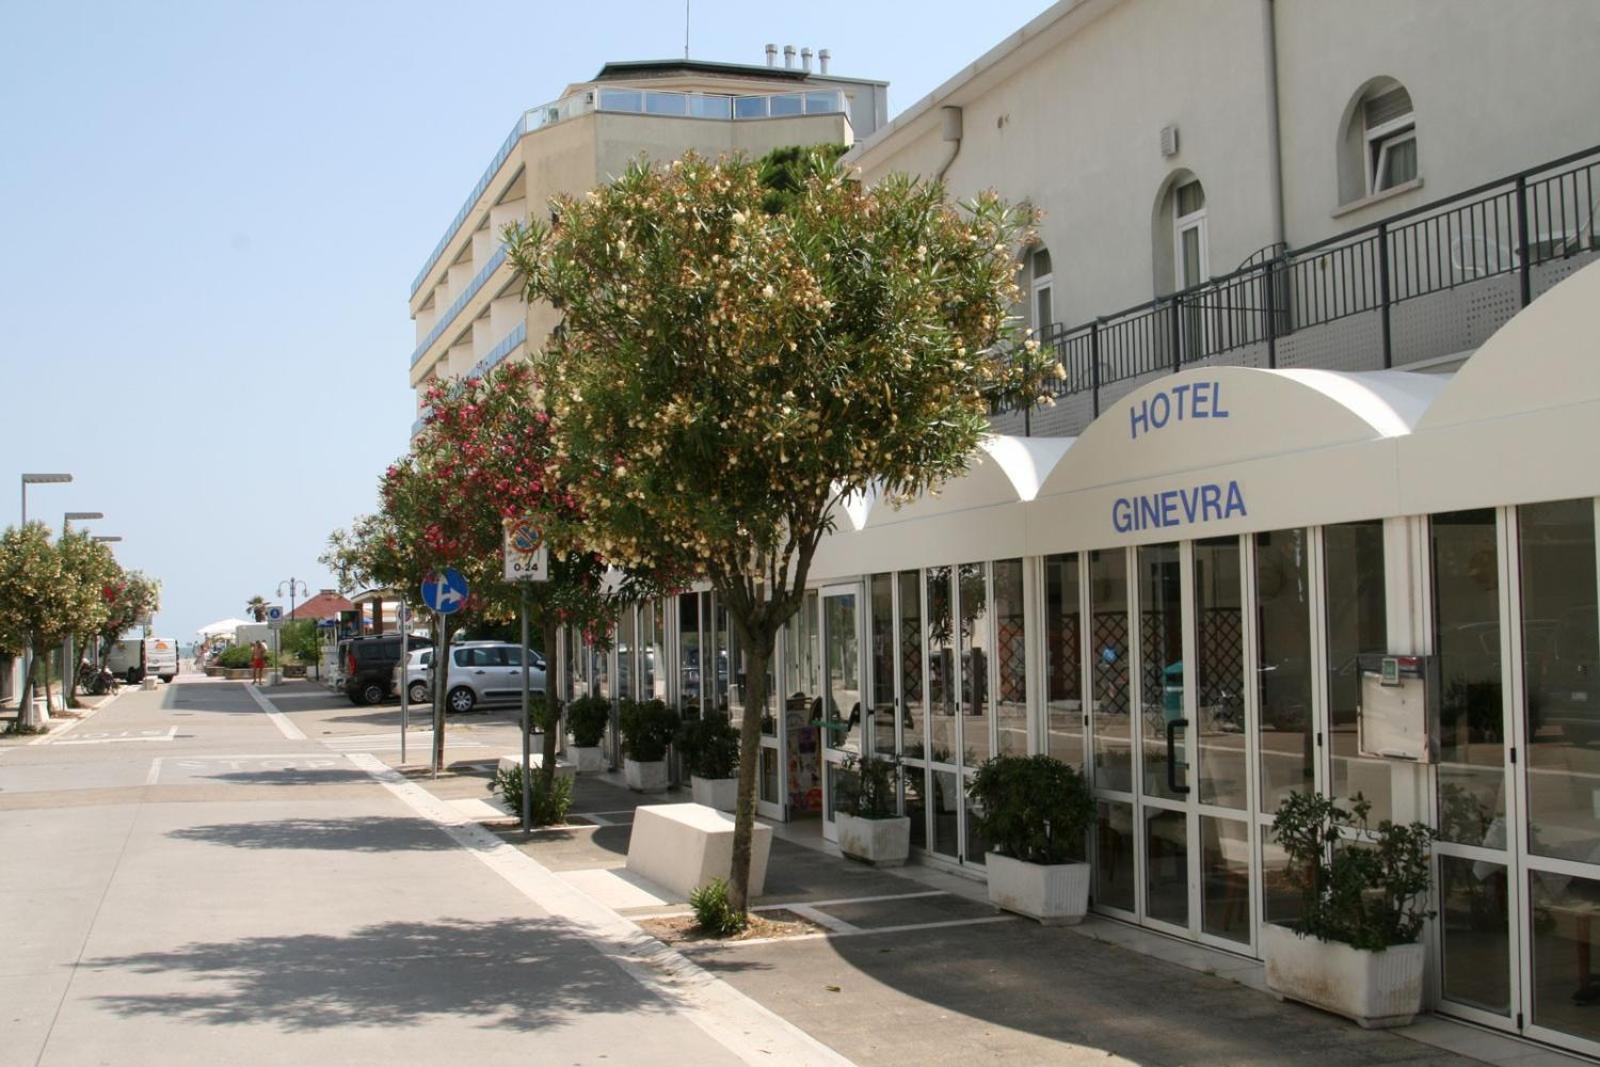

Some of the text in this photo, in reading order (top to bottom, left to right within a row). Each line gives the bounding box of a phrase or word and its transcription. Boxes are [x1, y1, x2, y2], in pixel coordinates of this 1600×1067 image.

[1130, 382, 1229, 438] HOTEL
[1112, 480, 1246, 533] GINEVRA
[513, 563, 539, 572] 0-24
[176, 759, 336, 769] STOP
